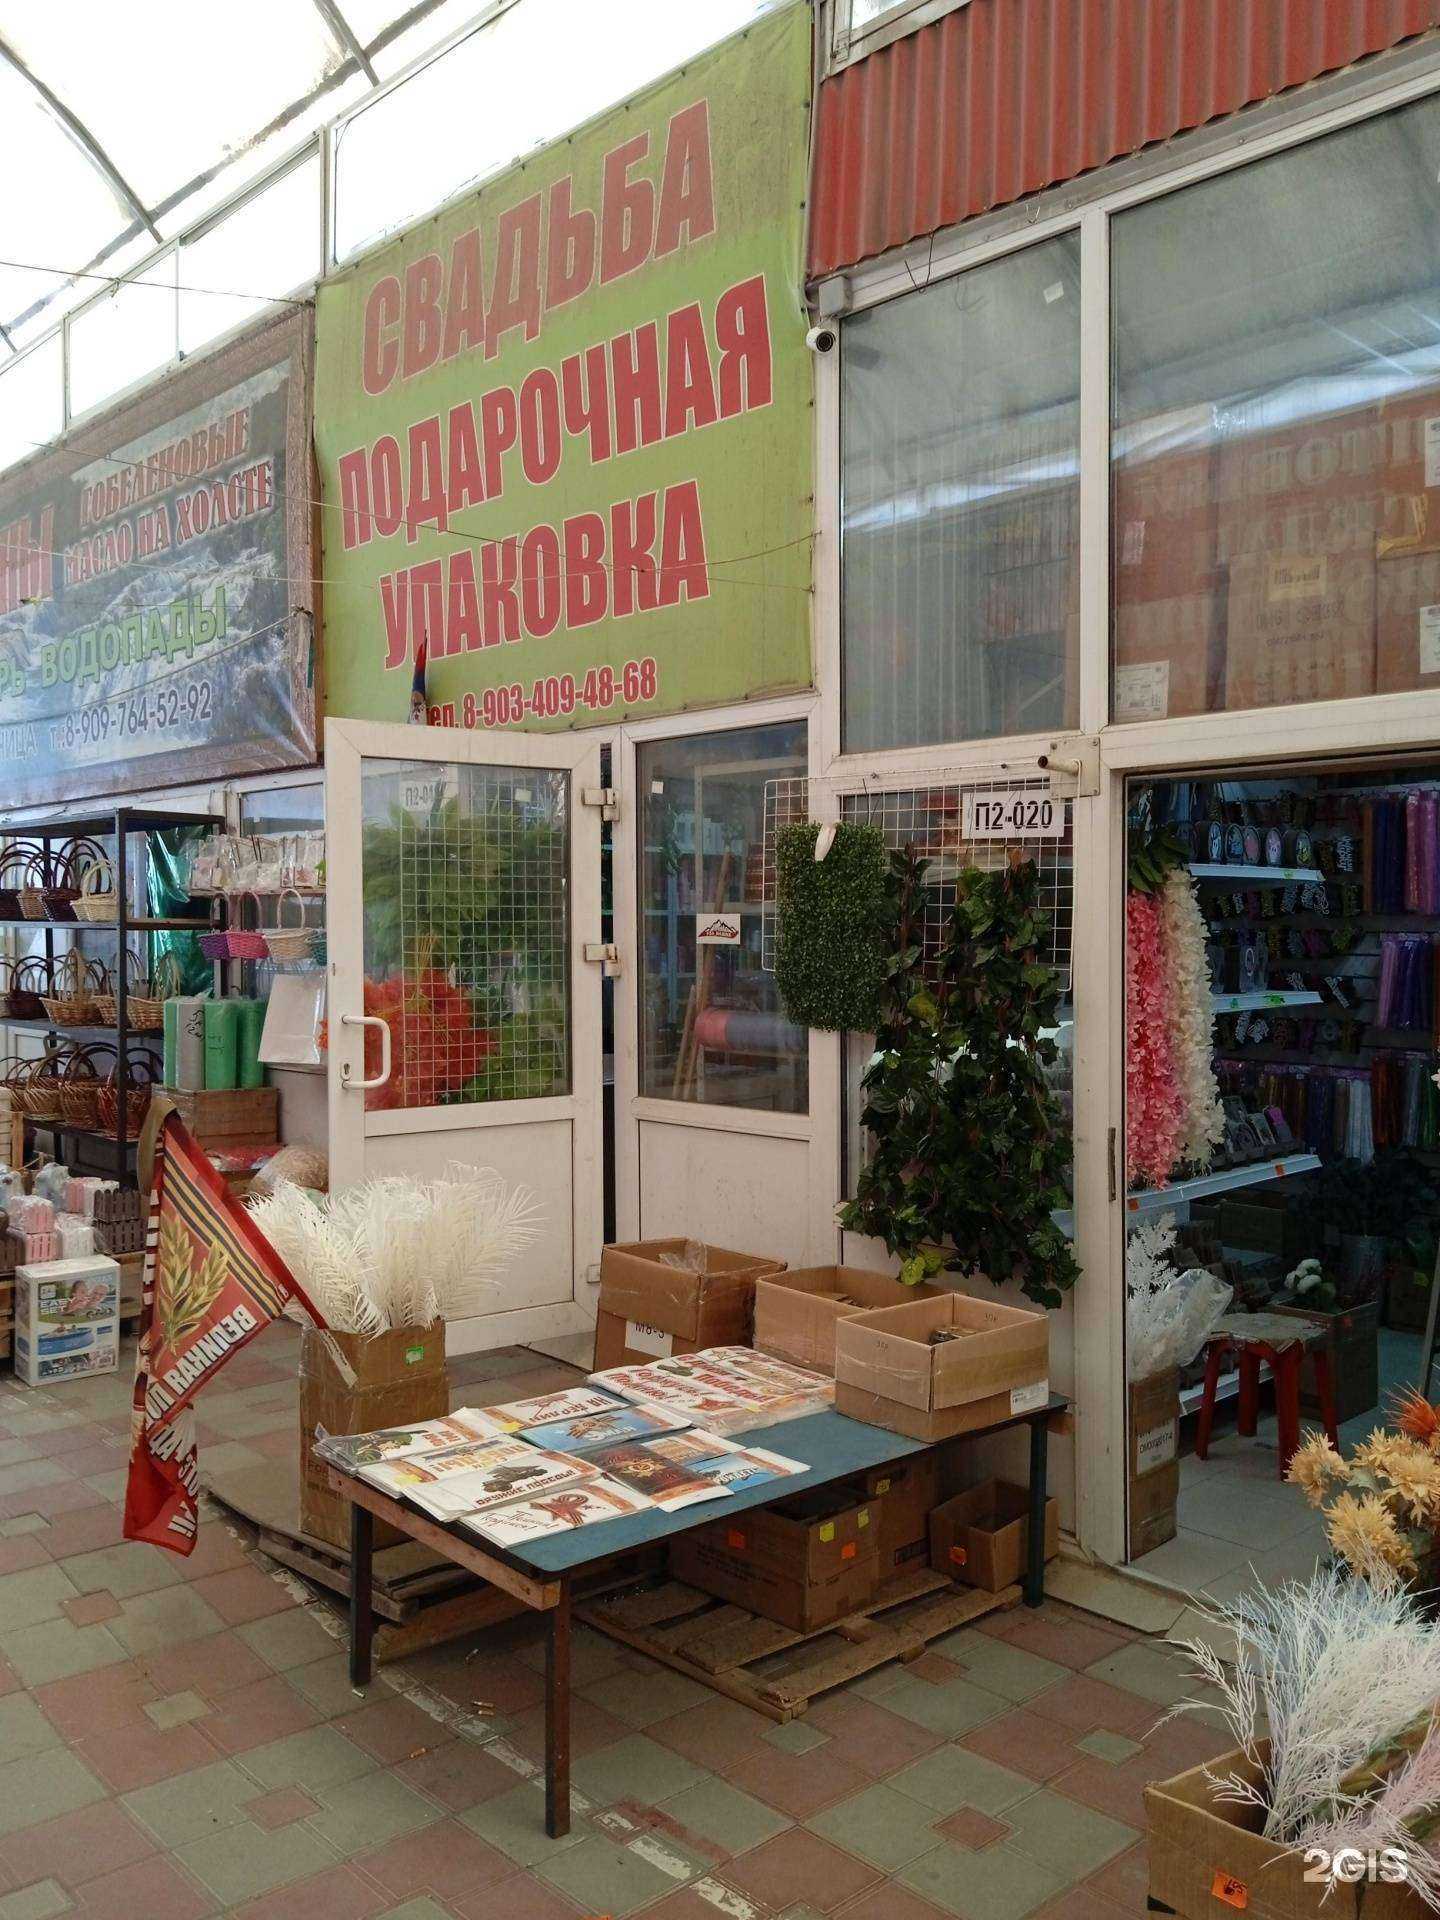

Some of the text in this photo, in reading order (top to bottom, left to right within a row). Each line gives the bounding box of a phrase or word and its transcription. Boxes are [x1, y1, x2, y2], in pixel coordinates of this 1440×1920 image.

[361, 97, 717, 396] СВАДЬБА
[80, 406, 251, 528] ГОБЕЛЕНОВЫЕ
[337, 272, 773, 550] ПОДАРОЧНАЯ
[64, 457, 275, 586] МАСЛО НА ХОЛСТЕ
[379, 479, 711, 671] УПАКОВКА
[41, 586, 228, 688] ВОДОПАДЫ
[463, 656, 657, 729] 8-903-409-48-68
[65, 681, 212, 747] 8-909-764-52-92
[975, 800, 1053, 830] П2-020
